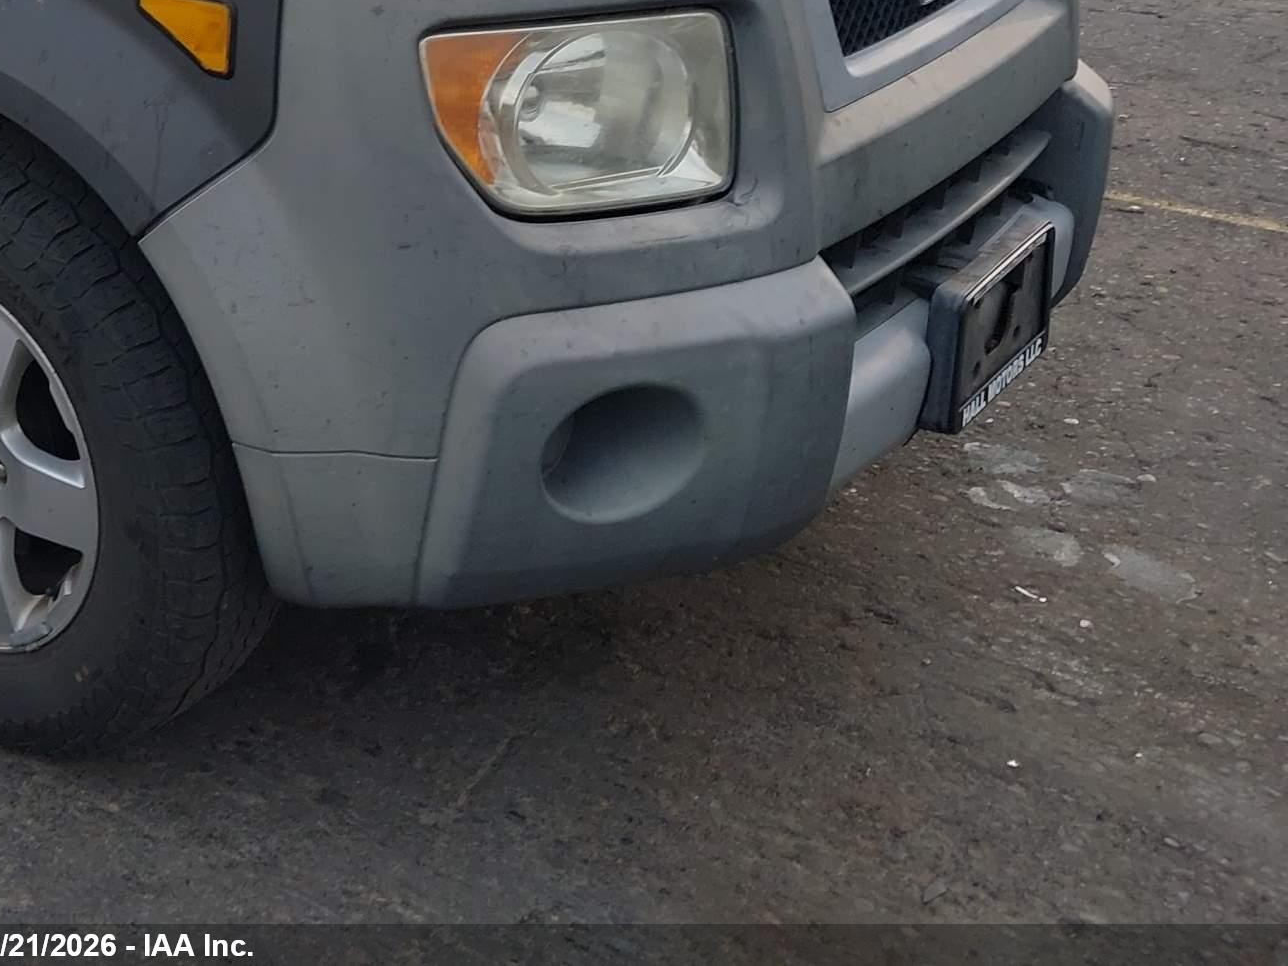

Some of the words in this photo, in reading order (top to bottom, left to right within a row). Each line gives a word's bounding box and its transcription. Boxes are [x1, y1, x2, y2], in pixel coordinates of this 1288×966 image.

[962, 391, 986, 427] HALL
[988, 354, 1024, 403] MOTORS
[1025, 338, 1042, 367] LLC
